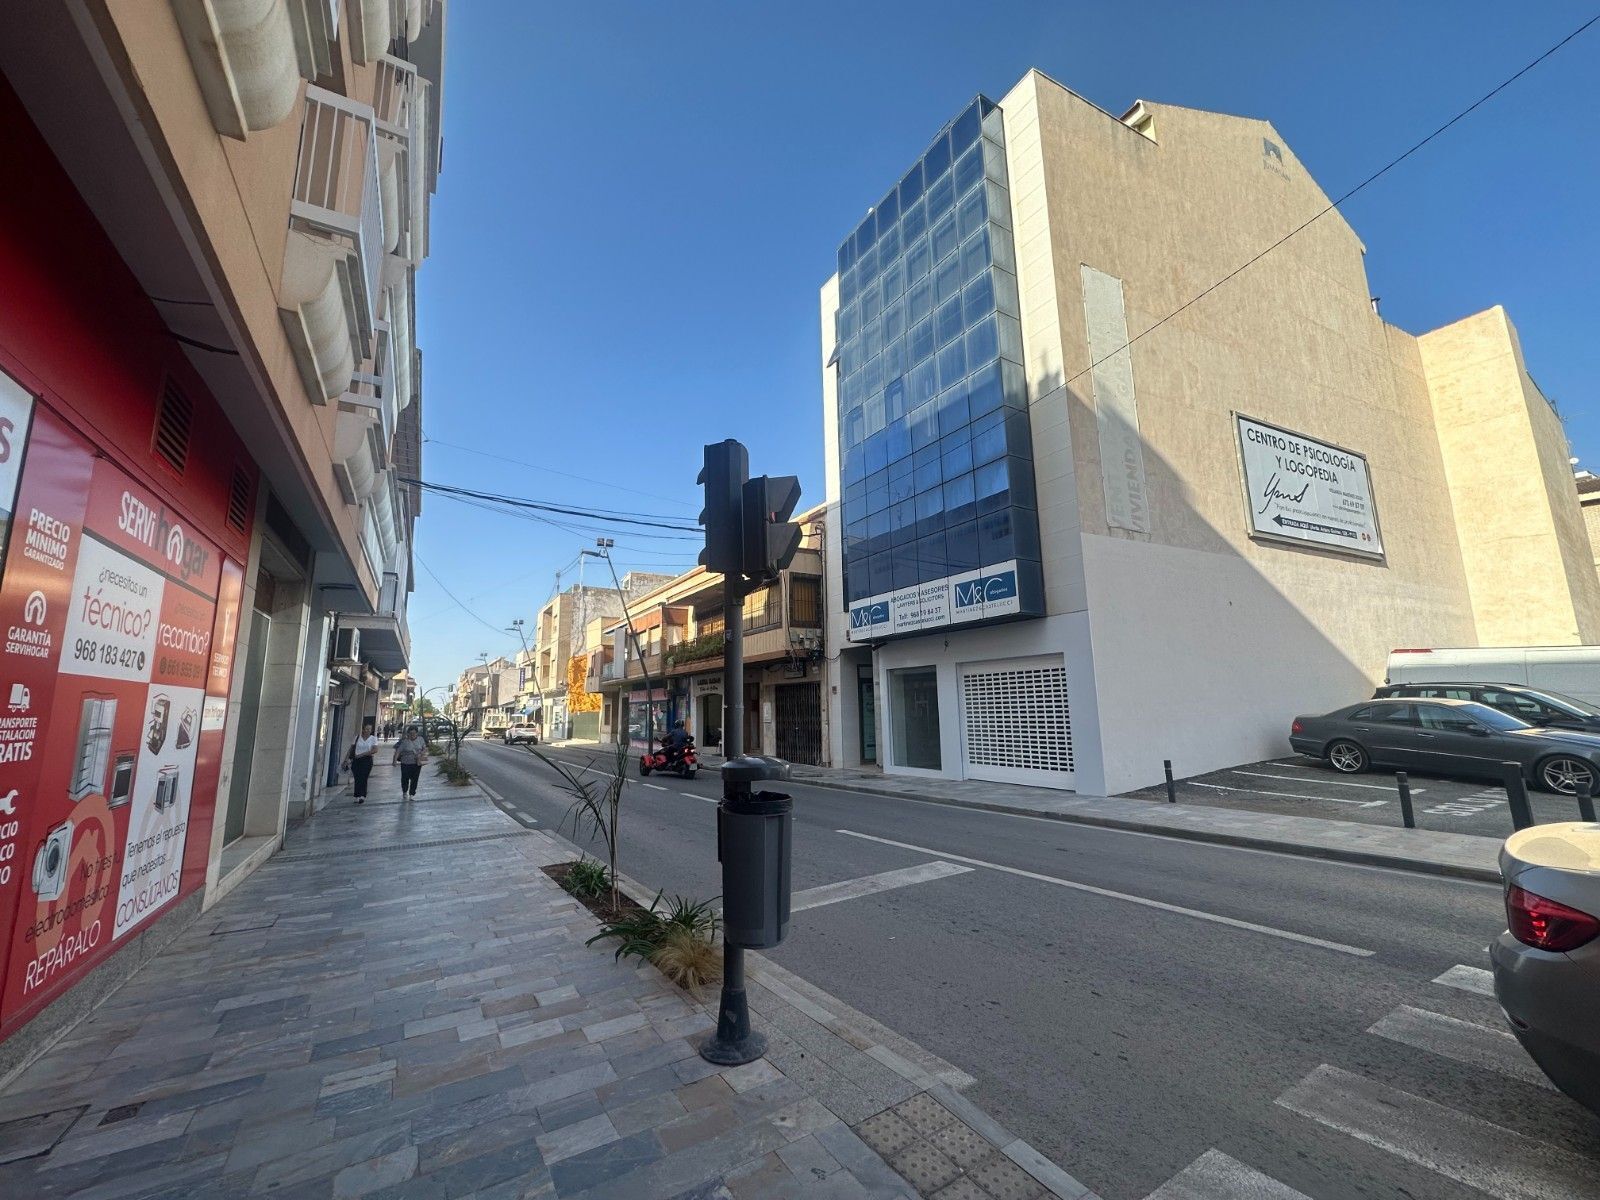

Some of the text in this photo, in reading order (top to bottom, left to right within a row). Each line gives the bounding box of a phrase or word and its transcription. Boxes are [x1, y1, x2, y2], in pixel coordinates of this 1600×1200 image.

[1246, 427, 1356, 472] CENTRO DE PSICOLOGÍA
[1275, 455, 1339, 485] Y LOGOPEDIA
[29, 507, 70, 543] PRECIO
[24, 546, 64, 570] GARANTIZADO
[139, 584, 148, 598] un
[890, 592, 917, 603] ABOGADOS
[921, 584, 949, 596] ASESORES
[82, 586, 152, 640] técnico?
[5, 641, 49, 659] SERVIHOGAR
[7, 625, 51, 647] GARANTÍA
[158, 621, 210, 656] recambio?
[75, 638, 137, 668] 968 183 427
[0, 729, 36, 741] TALACION
[128, 822, 186, 858] Tenemos el repuesto
[122, 869, 137, 890] que
[116, 870, 180, 928] CONSÚLTANOS
[23, 920, 101, 995] REPÁRALO
